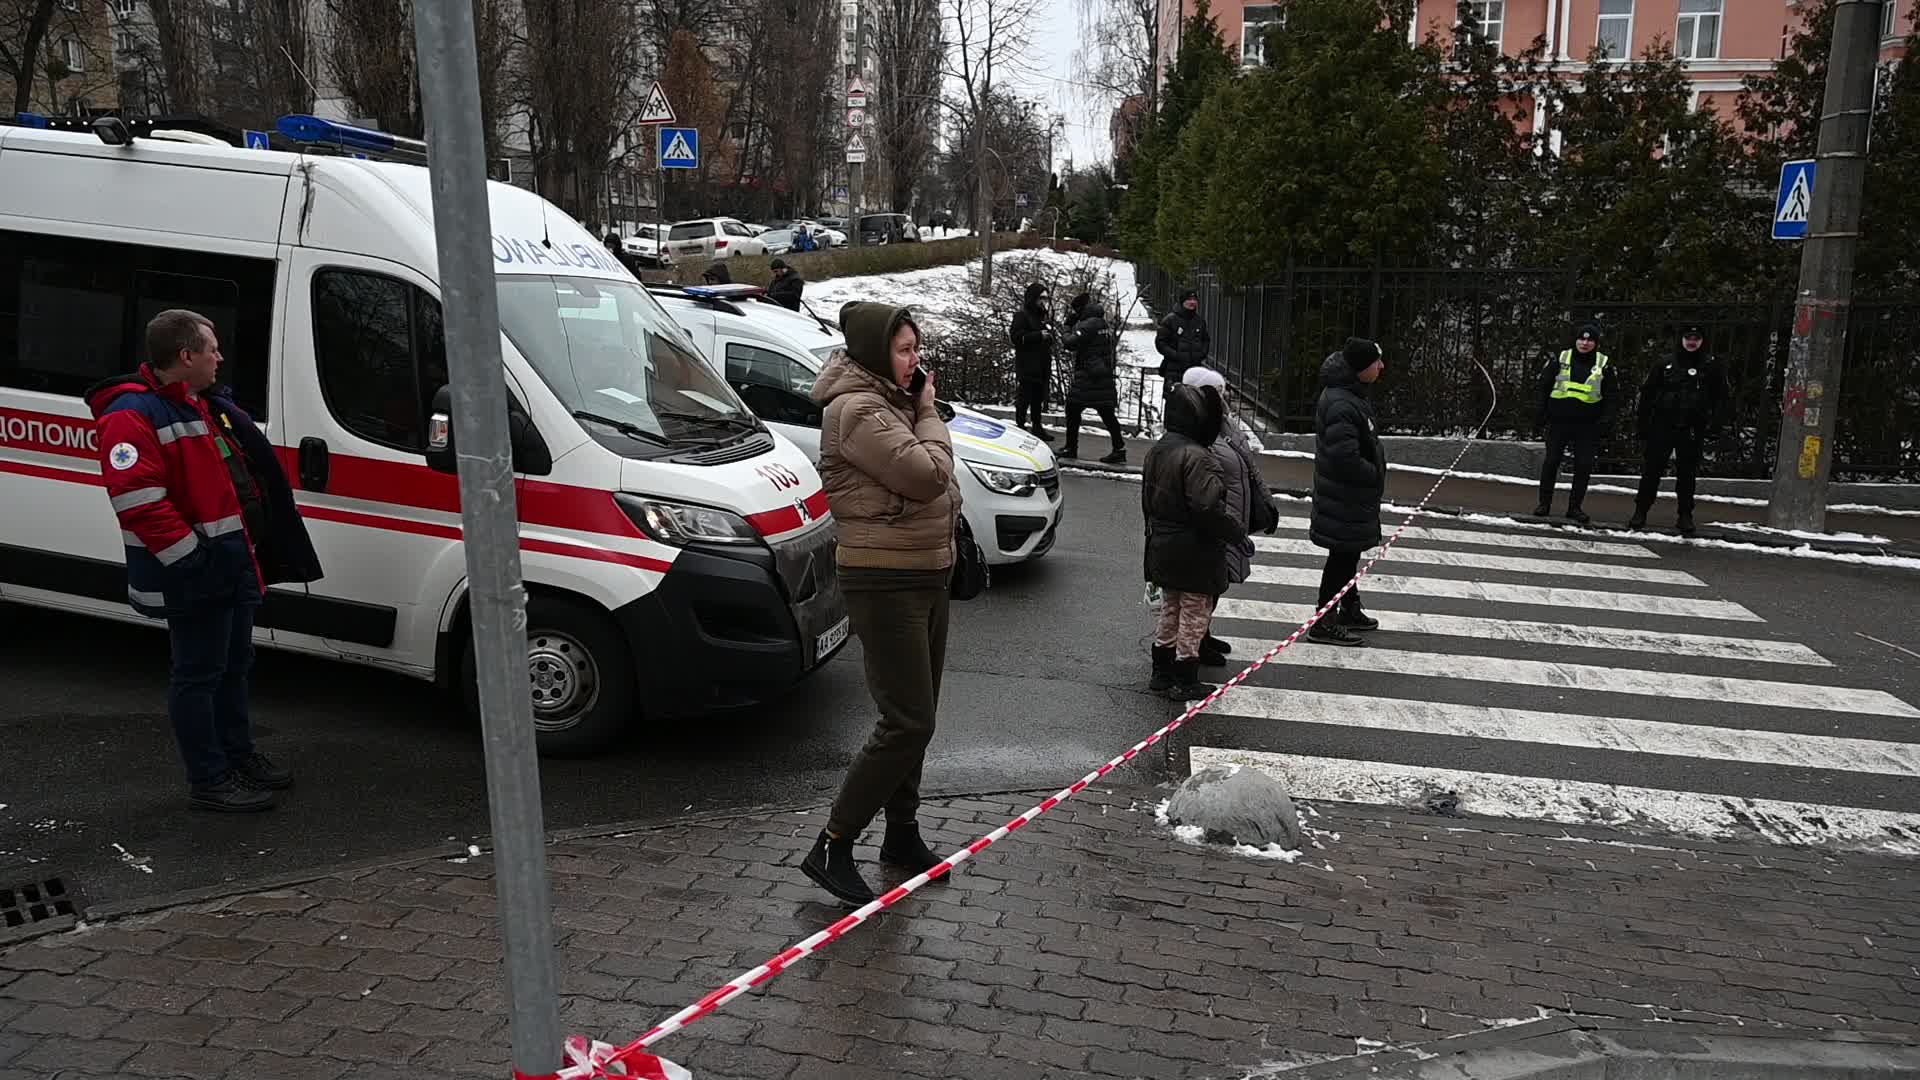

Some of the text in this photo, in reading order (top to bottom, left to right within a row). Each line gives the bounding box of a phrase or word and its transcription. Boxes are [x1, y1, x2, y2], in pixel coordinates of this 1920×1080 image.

[851, 114, 863, 123] 20
[0, 416, 98, 452] ОПОМО
[754, 463, 800, 492] 103
